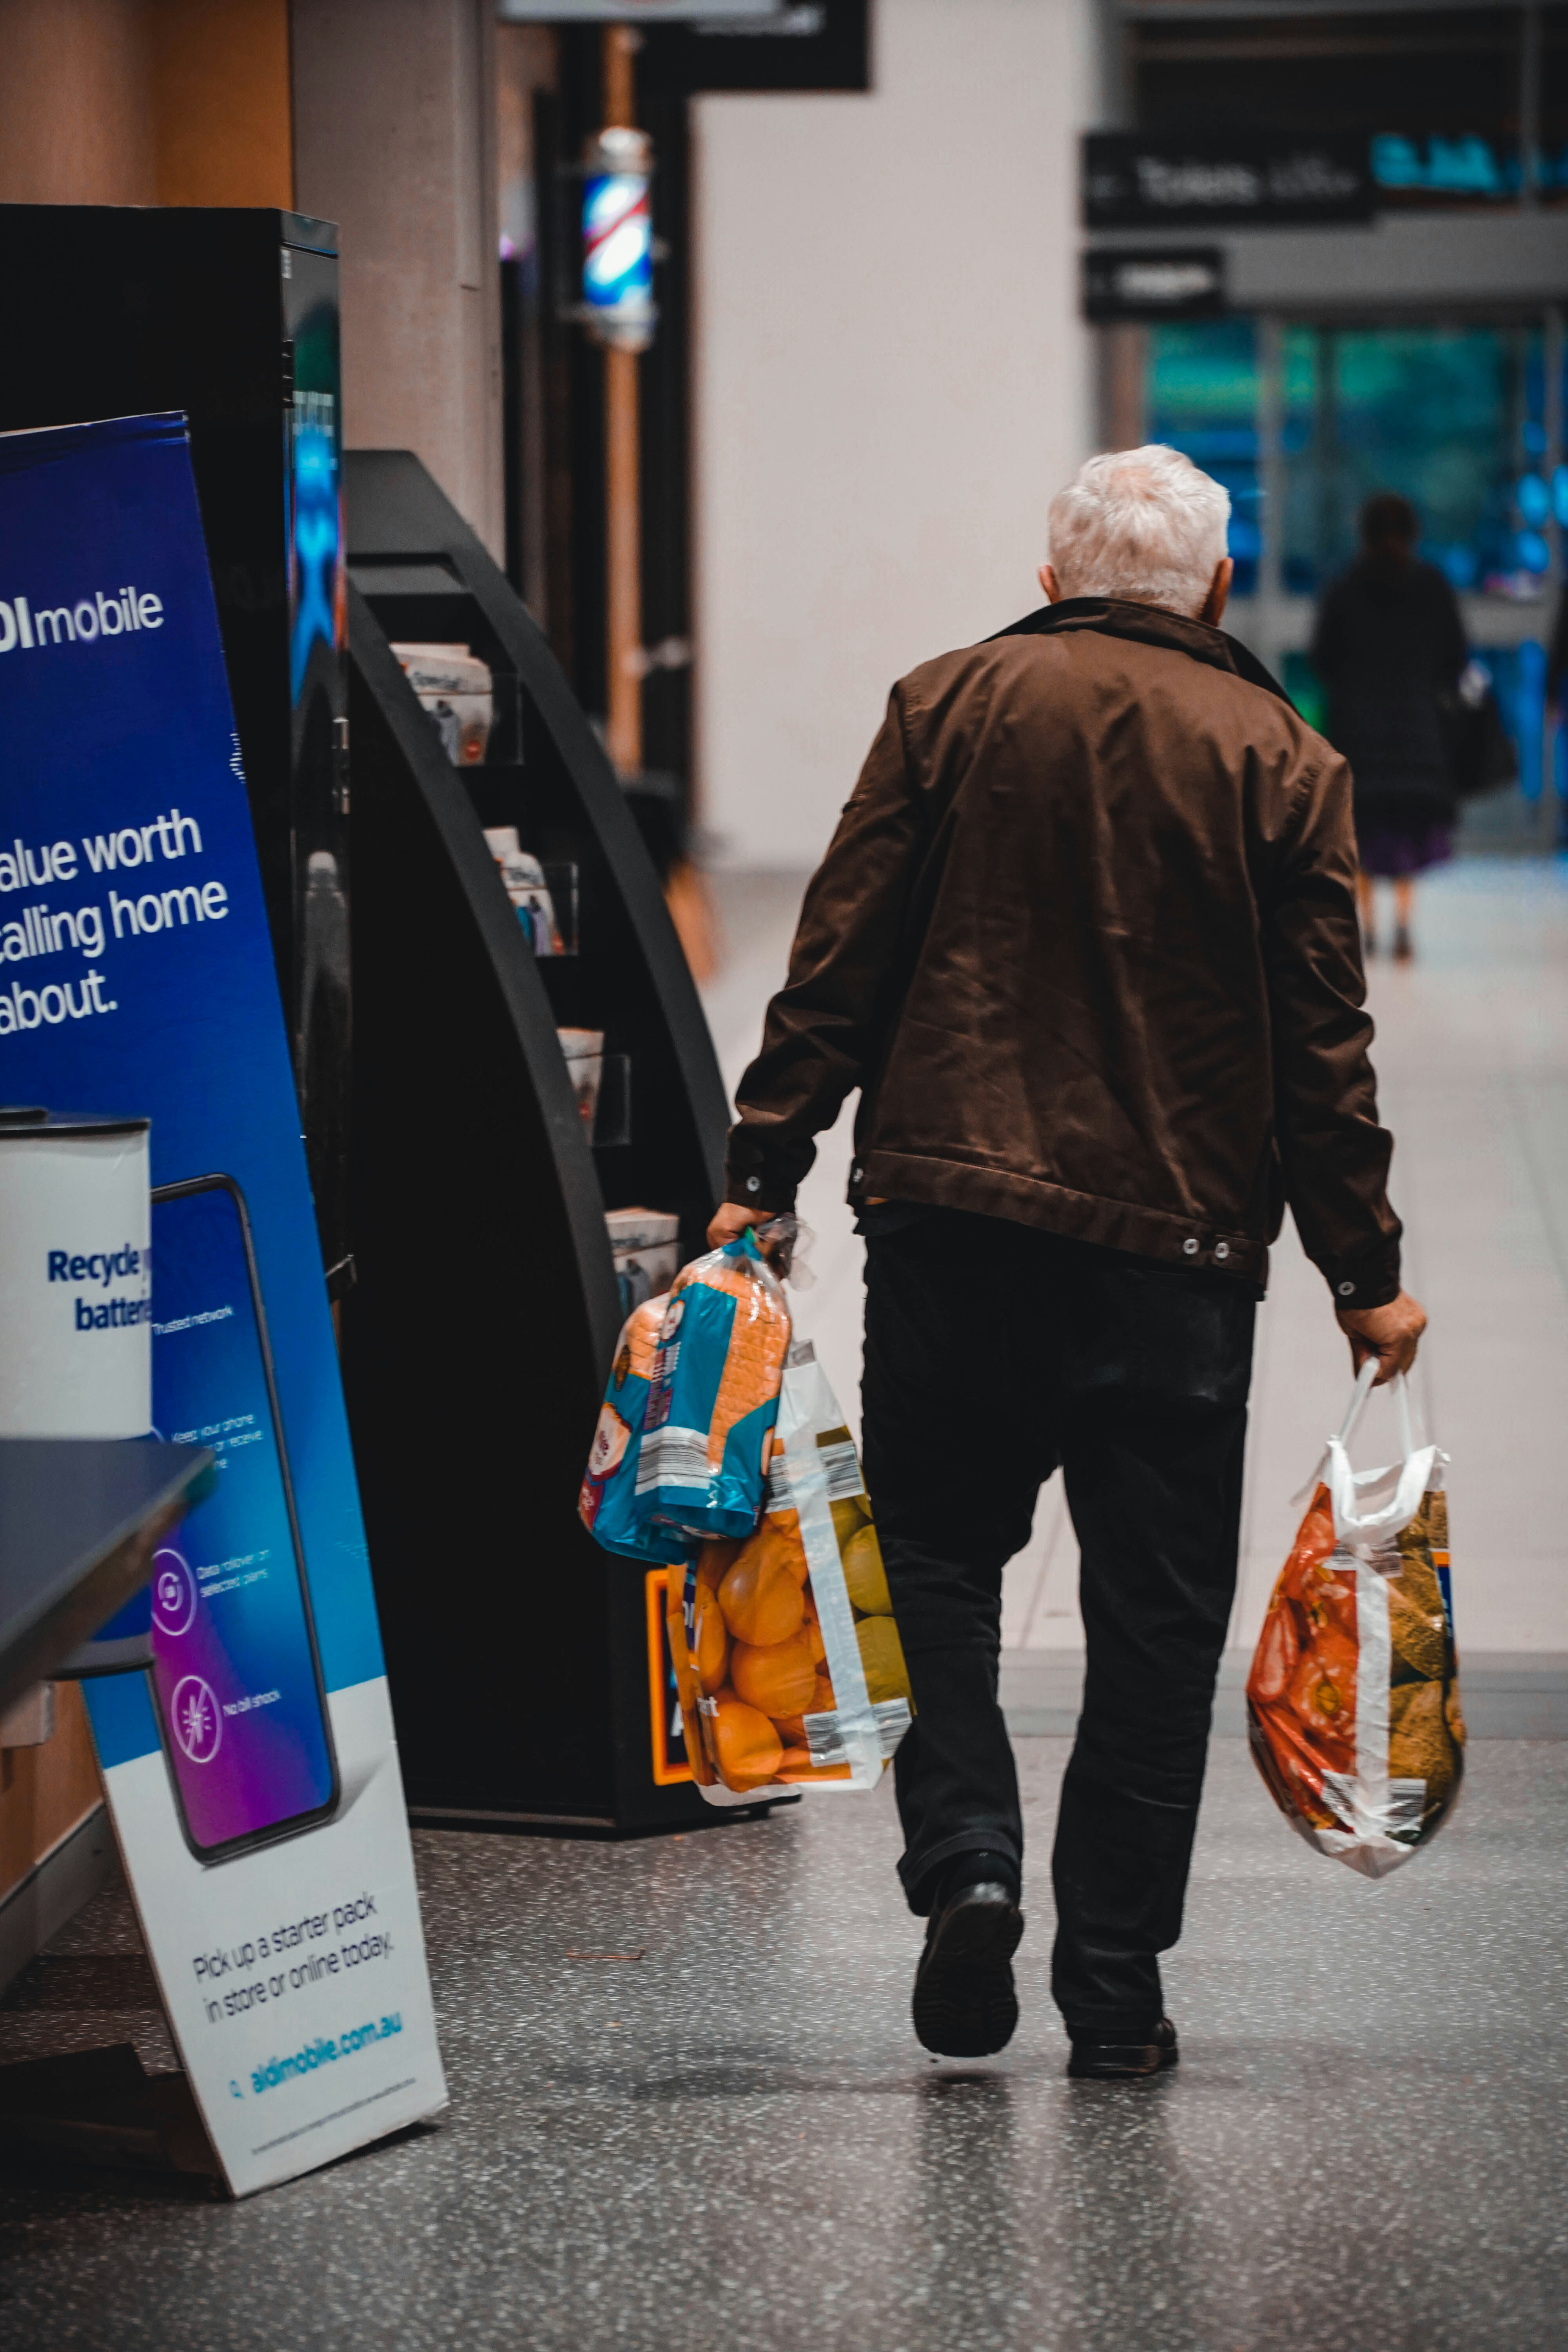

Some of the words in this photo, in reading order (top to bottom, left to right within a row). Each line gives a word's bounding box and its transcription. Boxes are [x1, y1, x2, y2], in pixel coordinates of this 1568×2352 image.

[82, 808, 203, 873] worth
[0, 904, 105, 964] alling
[108, 881, 229, 938] home
[0, 969, 118, 1035] about.
[48, 1243, 139, 1288] Recycle
[151, 1315, 191, 1336] Trusted
[191, 1305, 234, 1325] network
[222, 1415, 255, 1434] phone
[229, 1430, 264, 1447] receive
[197, 1564, 220, 1580] Data
[200, 1577, 240, 1598] selected
[223, 1703, 239, 1717] No
[237, 1696, 251, 1713] bill
[251, 1690, 281, 1708] shock
[192, 1947, 233, 1984] Pick
[231, 1942, 257, 1971] up
[257, 1937, 271, 1959] a
[272, 1912, 329, 1953] starter
[333, 1891, 378, 1936] pack
[202, 1998, 224, 2024] in
[223, 1982, 267, 2016] store
[268, 1973, 286, 1997] or
[289, 1952, 340, 1989] online
[341, 1932, 395, 1968] today.
[251, 2011, 403, 2094] aldimobile.com.au
